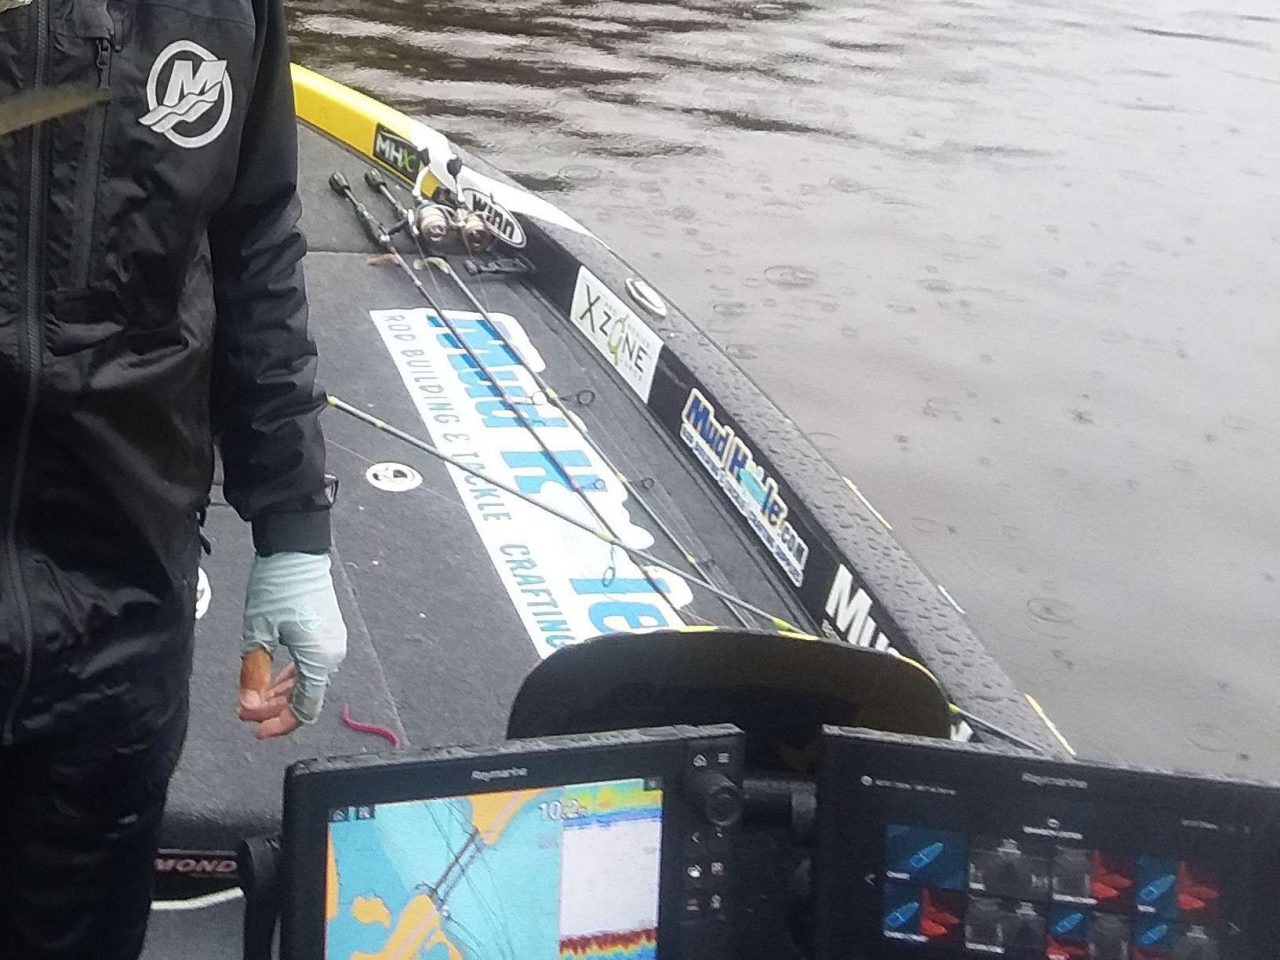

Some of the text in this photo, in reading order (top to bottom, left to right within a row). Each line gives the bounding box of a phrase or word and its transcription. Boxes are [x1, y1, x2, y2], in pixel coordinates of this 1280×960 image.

[375, 133, 417, 173] MHX
[384, 314, 417, 342] ROD
[400, 349, 461, 424] BUILDING
[687, 396, 731, 461] Mud
[451, 451, 512, 522] TACKLE
